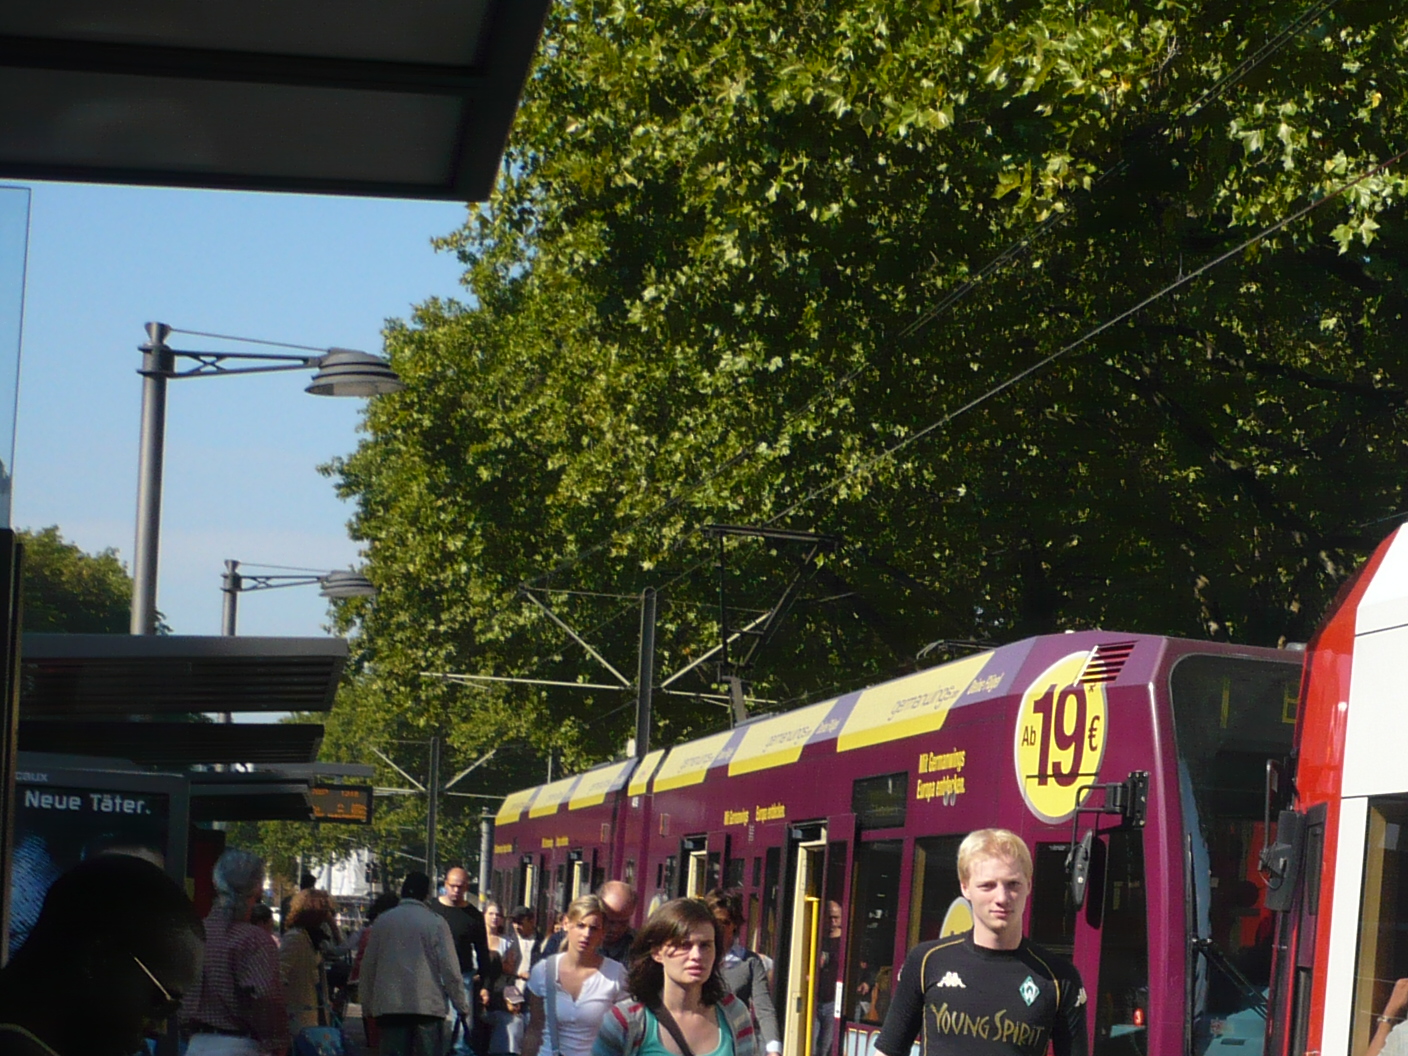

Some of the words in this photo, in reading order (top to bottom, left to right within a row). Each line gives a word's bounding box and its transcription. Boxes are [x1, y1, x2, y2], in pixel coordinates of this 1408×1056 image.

[1021, 725, 1036, 746] Ab
[1033, 683, 1087, 787] 19
[1088, 715, 1100, 752] €
[15, 772, 49, 782] caux
[24, 789, 82, 811] Neue
[90, 793, 152, 815] Täter.
